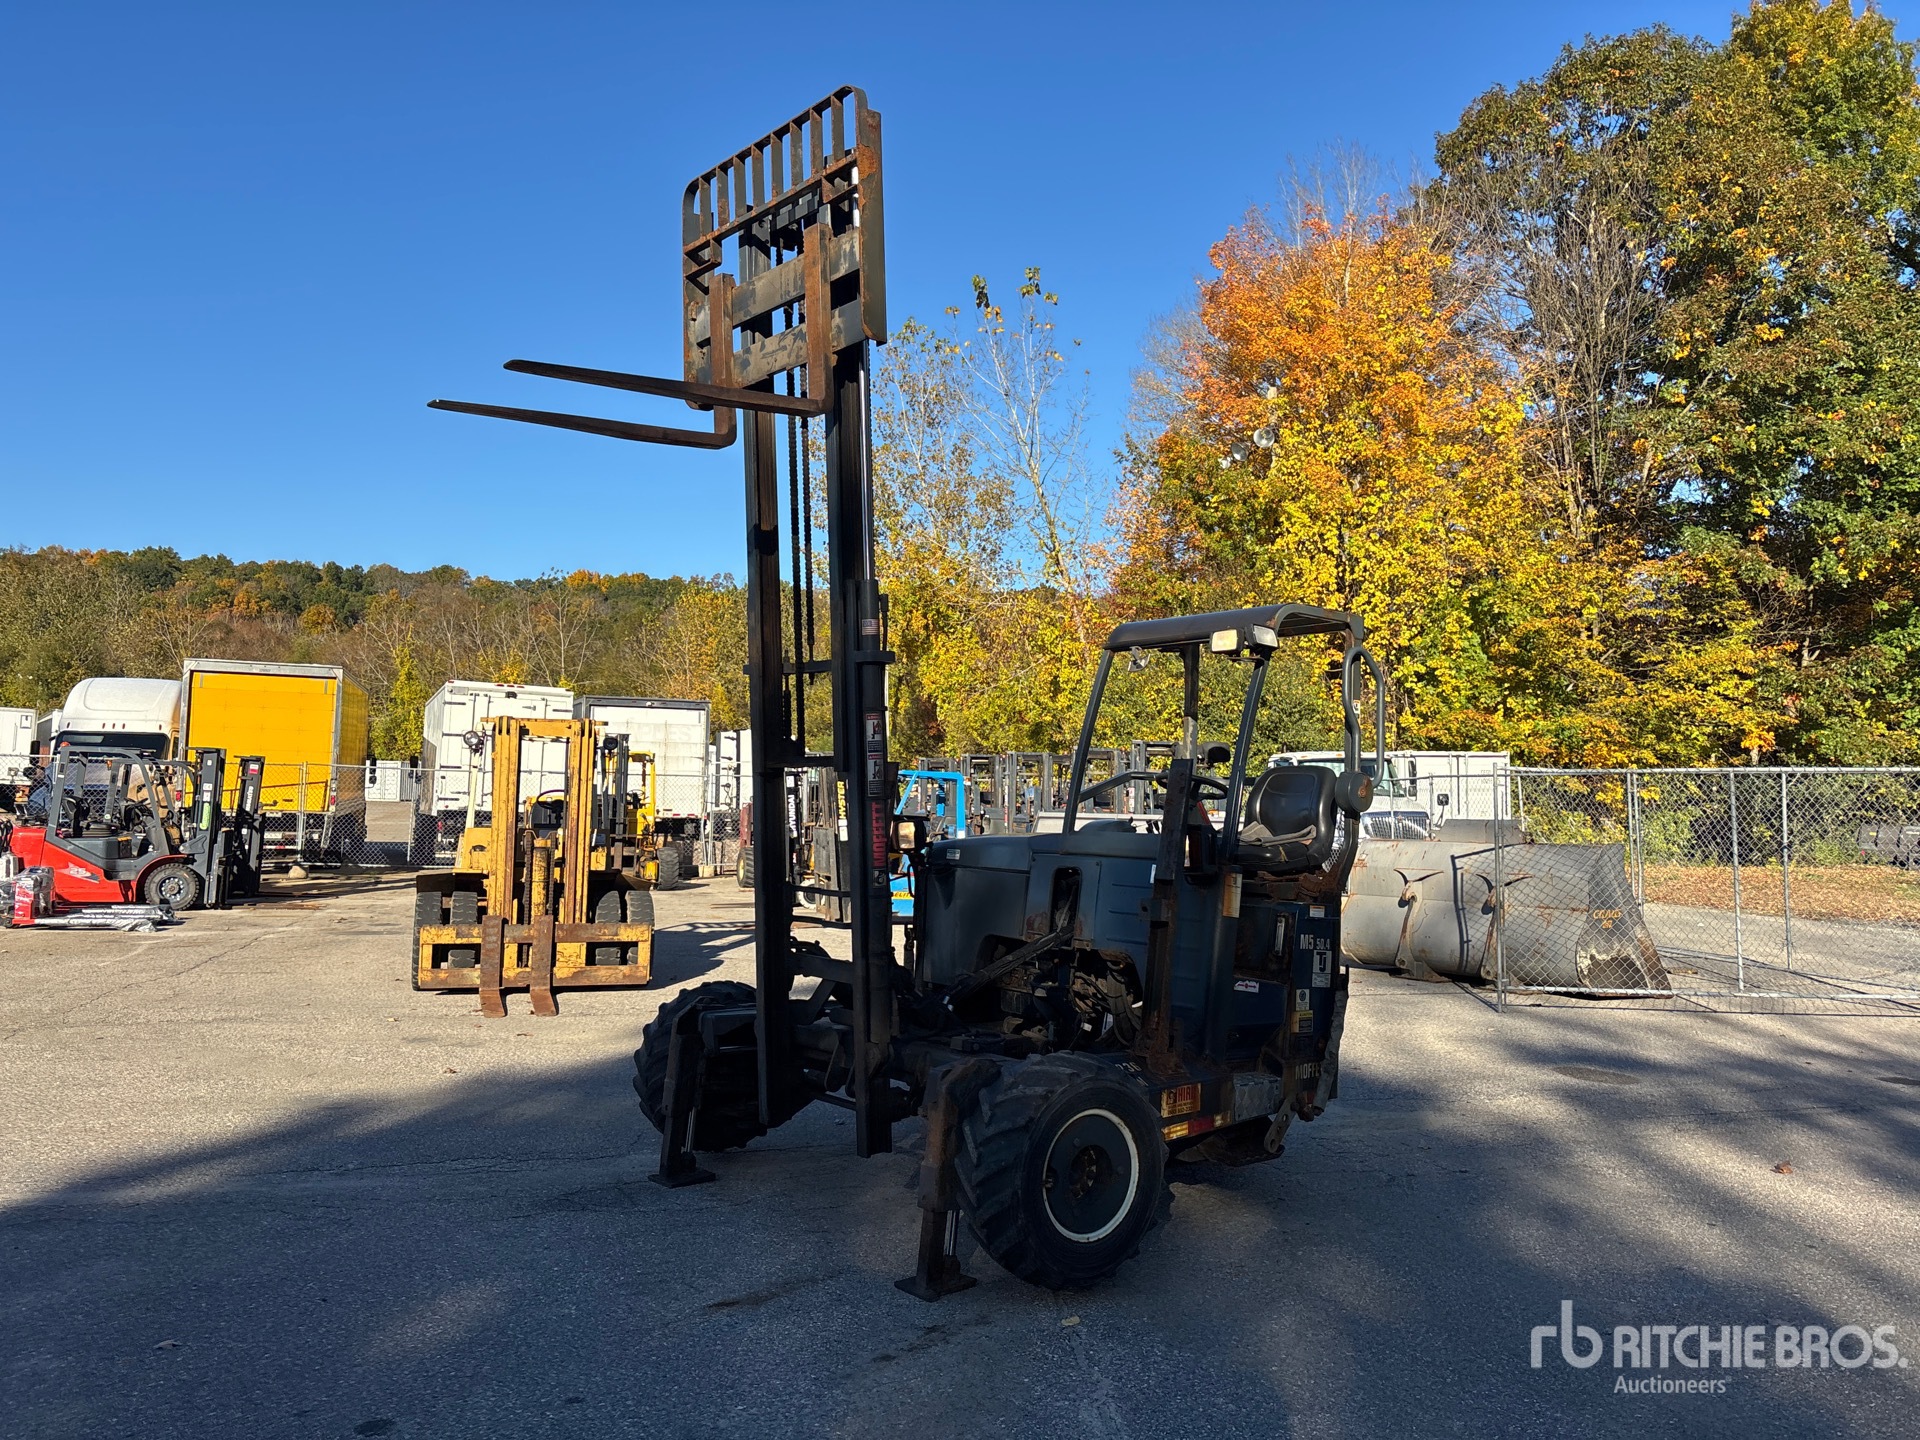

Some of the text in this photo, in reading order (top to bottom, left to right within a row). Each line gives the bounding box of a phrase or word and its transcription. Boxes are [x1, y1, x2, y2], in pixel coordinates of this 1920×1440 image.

[837, 781, 847, 819] HYSTER
[872, 801, 886, 867] MOFFETT
[1300, 934, 1314, 950] M5
[1295, 1062, 1320, 1080] MOFFE
